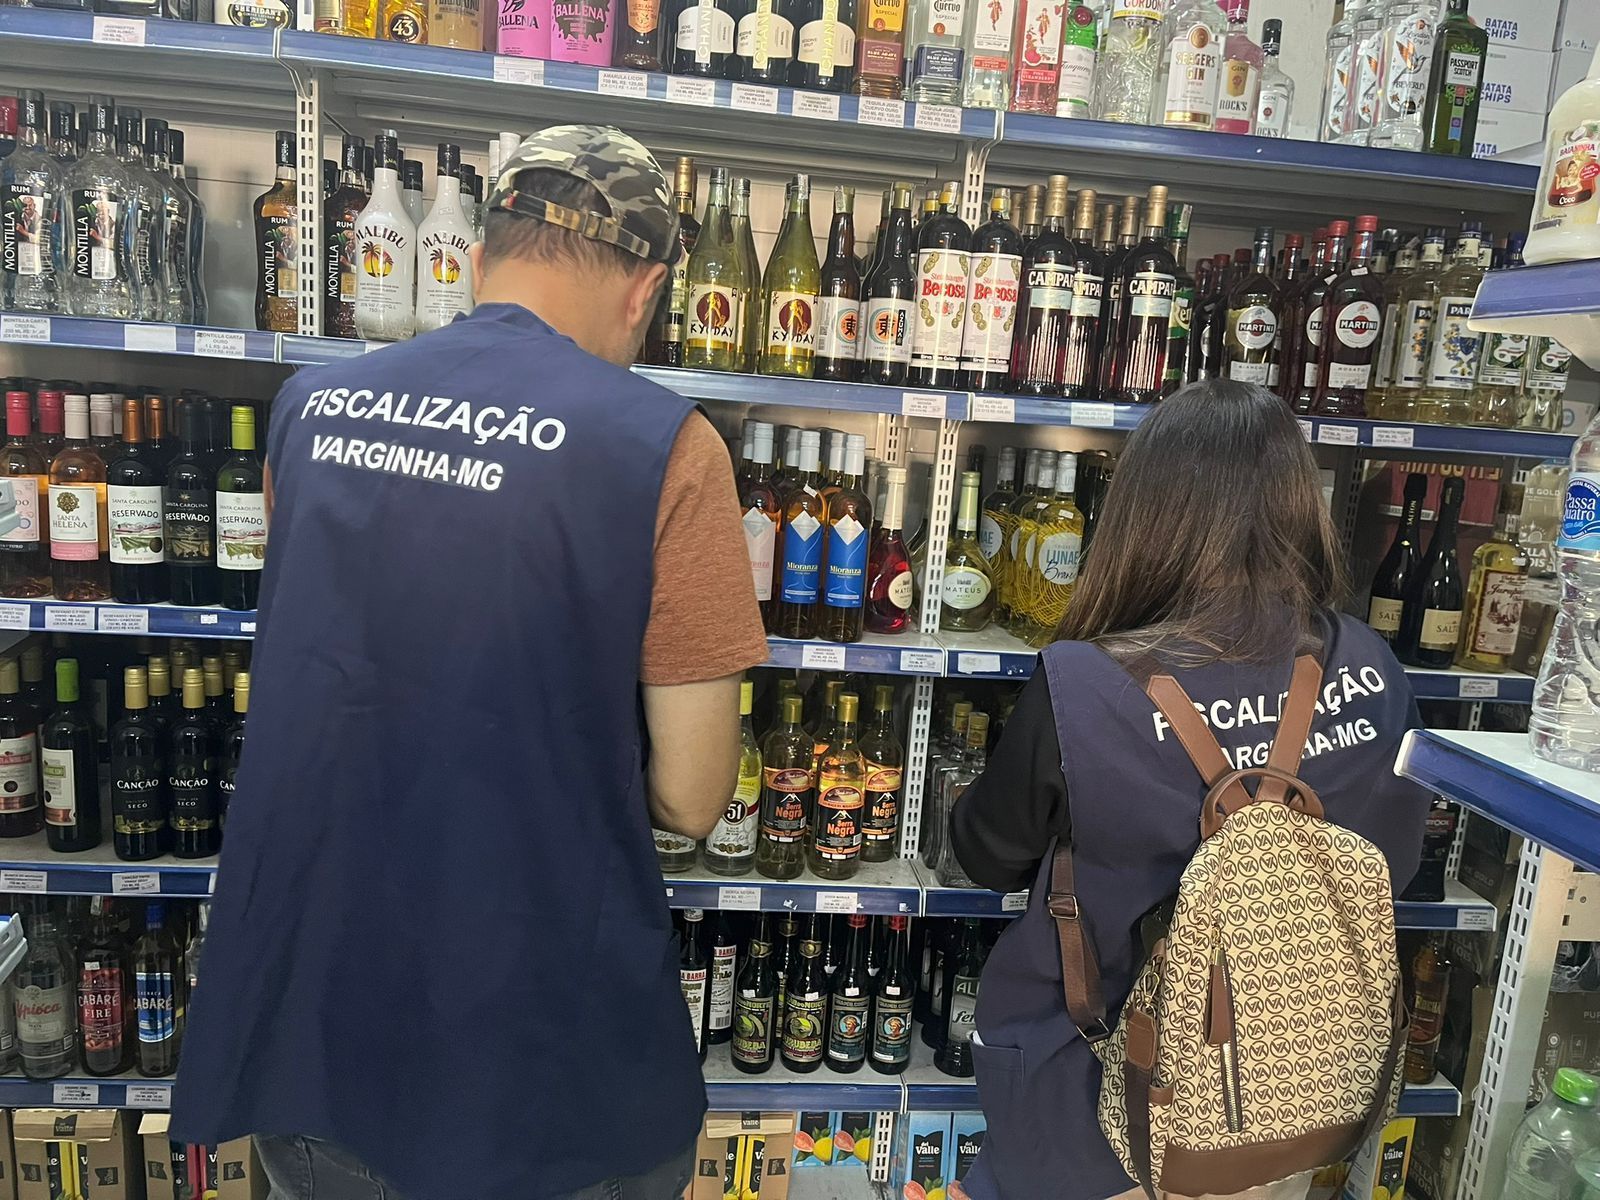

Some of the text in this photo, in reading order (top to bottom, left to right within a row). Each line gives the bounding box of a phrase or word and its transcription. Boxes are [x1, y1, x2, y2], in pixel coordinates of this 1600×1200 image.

[556, 3, 605, 22] BALLENA
[933, 2, 961, 13] Cuervo
[392, 18, 414, 37] 43
[1485, 18, 1518, 31] BATATA
[1176, 53, 1216, 68] SEAGERS
[1450, 59, 1478, 69] PASSPORT
[1187, 66, 1205, 80] GIN
[1454, 67, 1472, 76] SCOTCH
[1219, 99, 1248, 112] ROCK'S
[1475, 143, 1497, 155] TATA
[11, 184, 31, 195] RUM
[1559, 194, 1576, 205] Coco
[336, 220, 354, 229] RUM
[3, 210, 17, 271] MONTILLA
[356, 225, 407, 250] MALIBU
[75, 216, 89, 276] MONTILLA
[264, 240, 276, 293] MONTILLA
[327, 244, 340, 298] MONTILLA
[1239, 321, 1274, 334] MARTINI
[1340, 318, 1376, 331] MARTINI
[300, 387, 567, 452] FISCALIZAÇÃO
[1536, 488, 1561, 497] GOLD
[112, 510, 159, 519] RESERVADO
[165, 512, 211, 523] RESERVADO
[219, 515, 263, 526] RESERVADO
[1565, 507, 1596, 522] uatro
[53, 520, 88, 529] HELENA
[1046, 549, 1079, 565] LUNAE
[787, 561, 819, 573] Mioranza
[829, 564, 862, 577] Mioranza
[945, 586, 982, 595] MATEUS
[117, 778, 159, 791] CANÇÃO
[169, 776, 209, 789] CANÇÃO
[220, 780, 236, 791] CAN
[727, 803, 742, 820] 51
[776, 807, 803, 820] Negra
[872, 806, 897, 819] Negra
[827, 824, 855, 838] Negra
[78, 992, 120, 1007] CABARÉ
[85, 1008, 112, 1018] FIRE
[172, 1152, 186, 1160] lle
[916, 1145, 940, 1155] Valle
[1384, 1150, 1403, 1160] Valle
